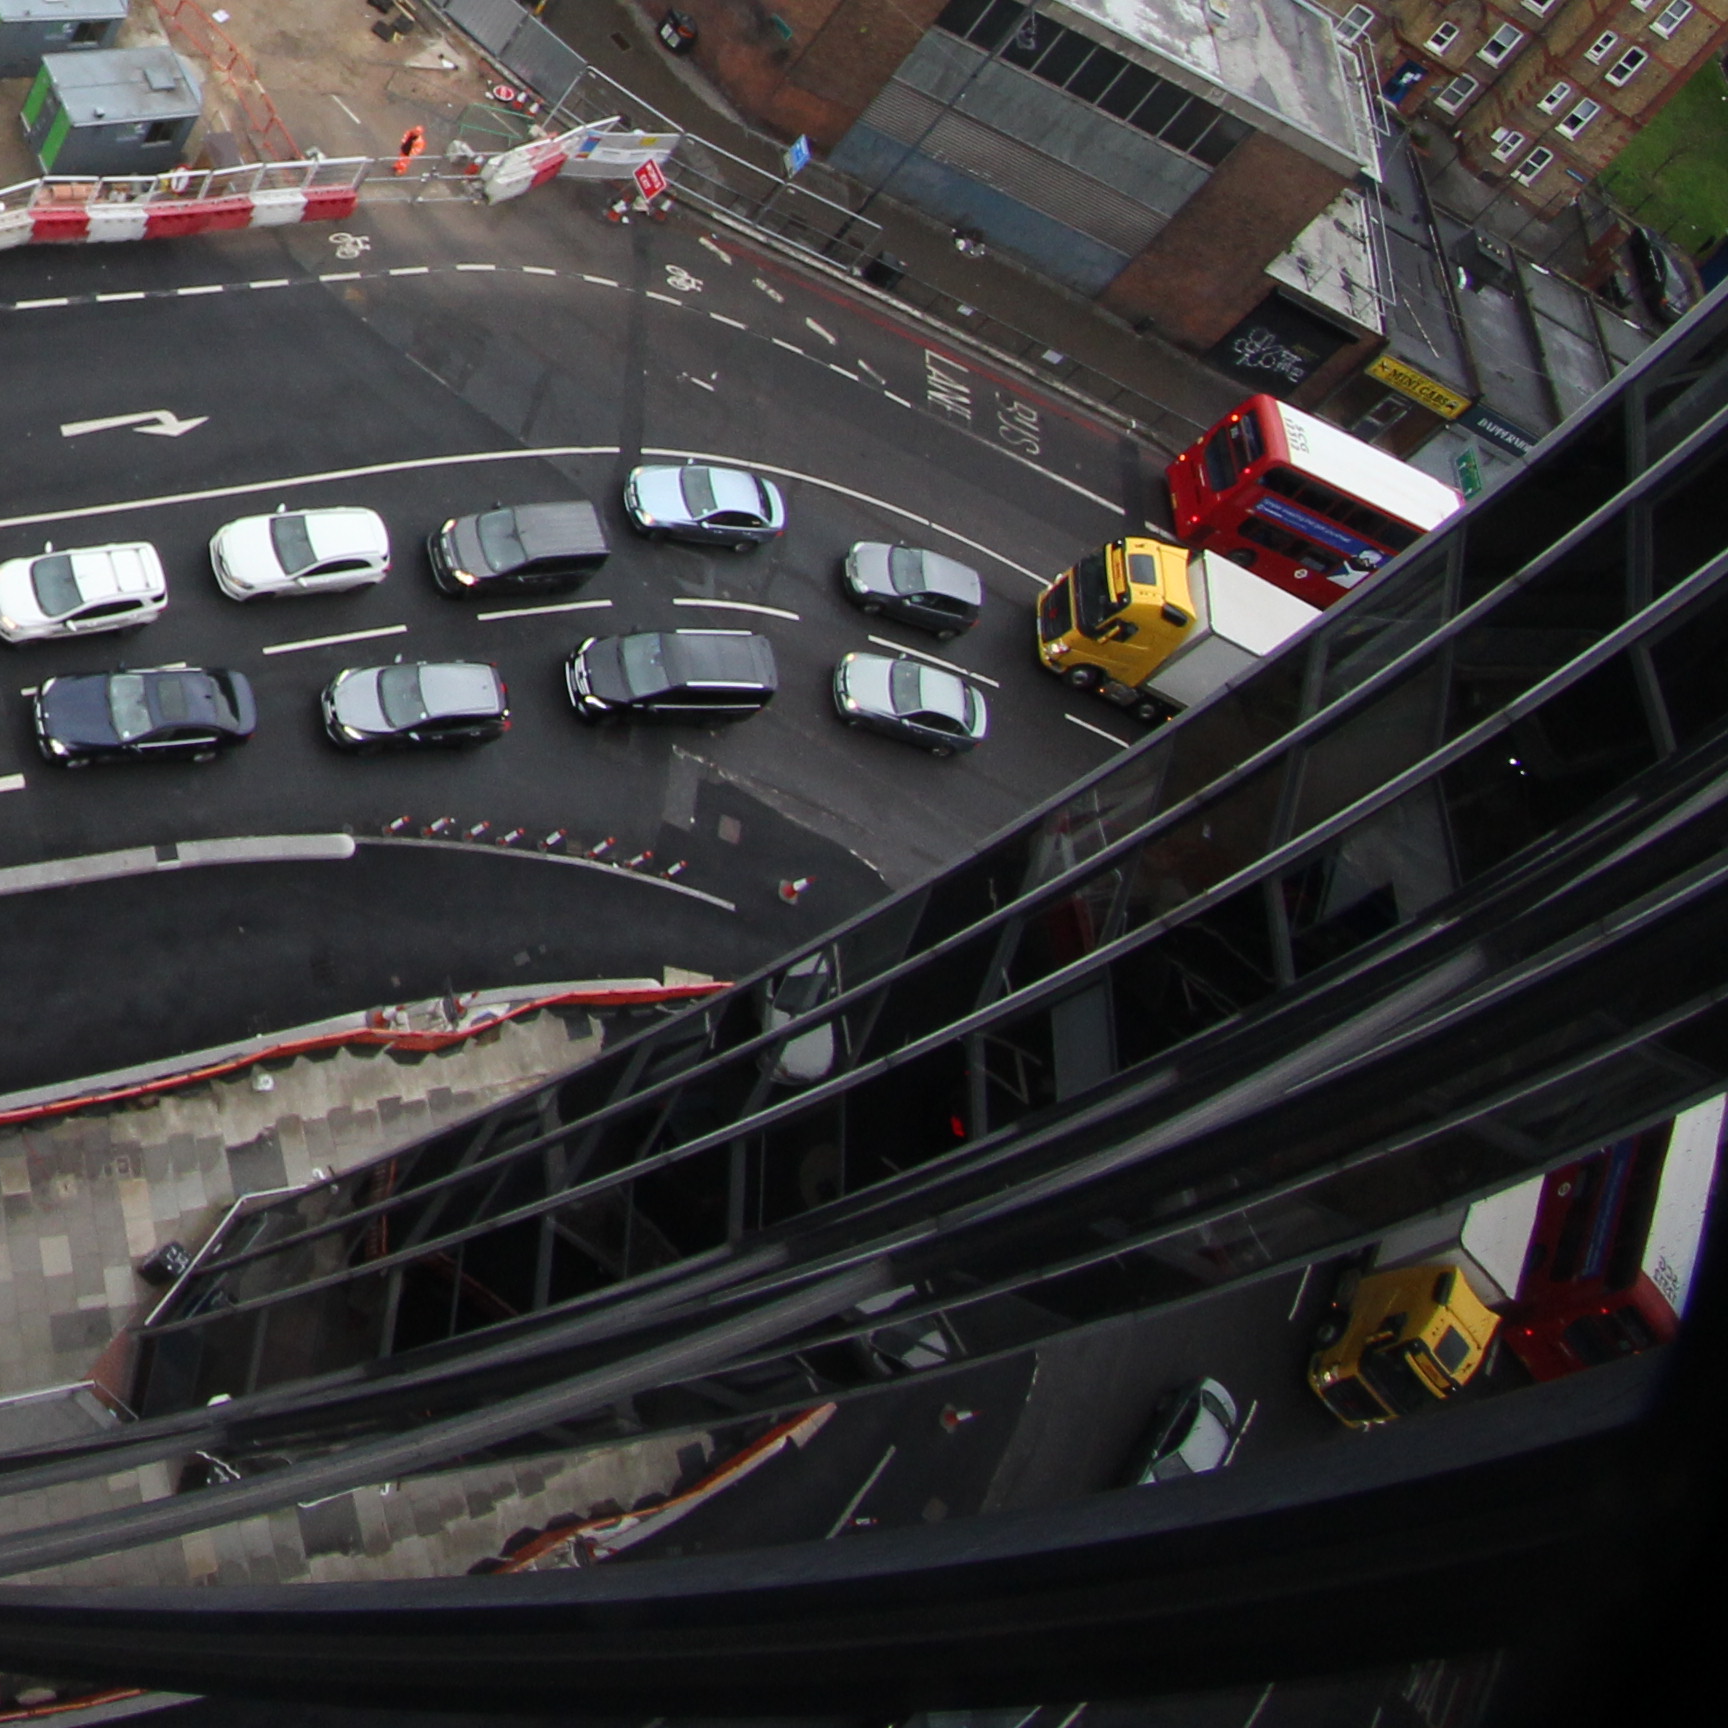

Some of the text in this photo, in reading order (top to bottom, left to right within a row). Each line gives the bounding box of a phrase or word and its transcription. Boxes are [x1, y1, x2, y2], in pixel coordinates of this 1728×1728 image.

[925, 348, 971, 420] LANE
[1390, 369, 1448, 406] MINI CABS
[994, 391, 1040, 455] BUS
